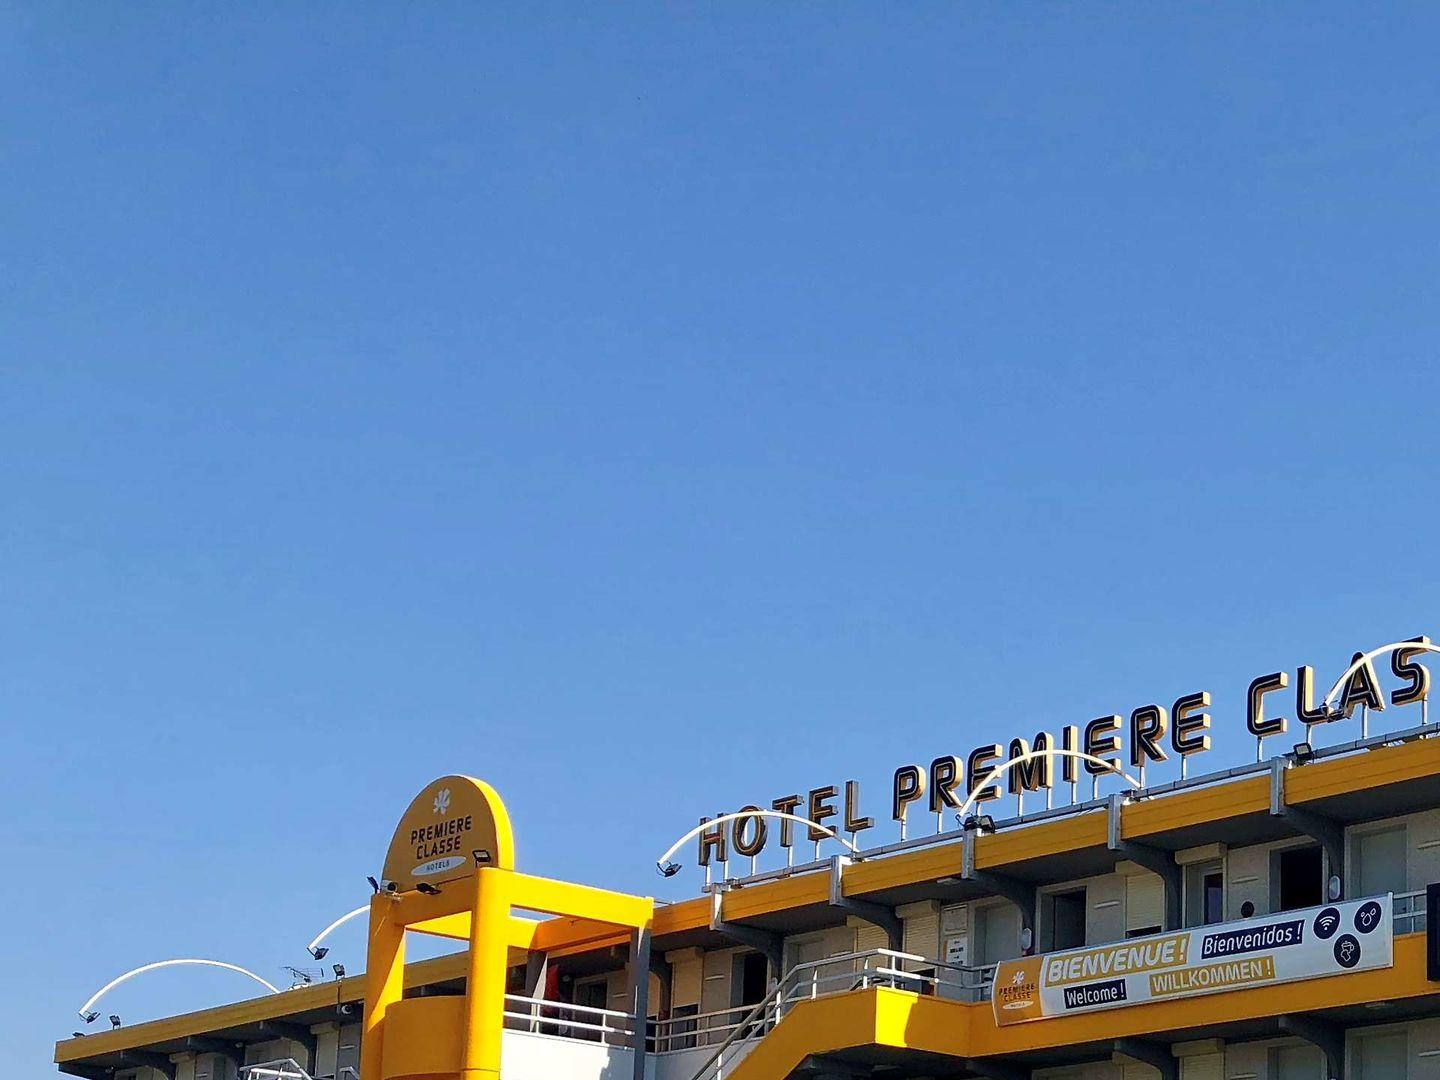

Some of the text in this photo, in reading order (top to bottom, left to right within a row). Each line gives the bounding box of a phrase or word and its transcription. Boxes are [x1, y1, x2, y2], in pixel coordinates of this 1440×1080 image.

[699, 780, 875, 866] HOTEL
[892, 691, 1211, 821] PREMIERE
[411, 815, 472, 845] PREMIERE
[416, 836, 461, 860] CLASSE
